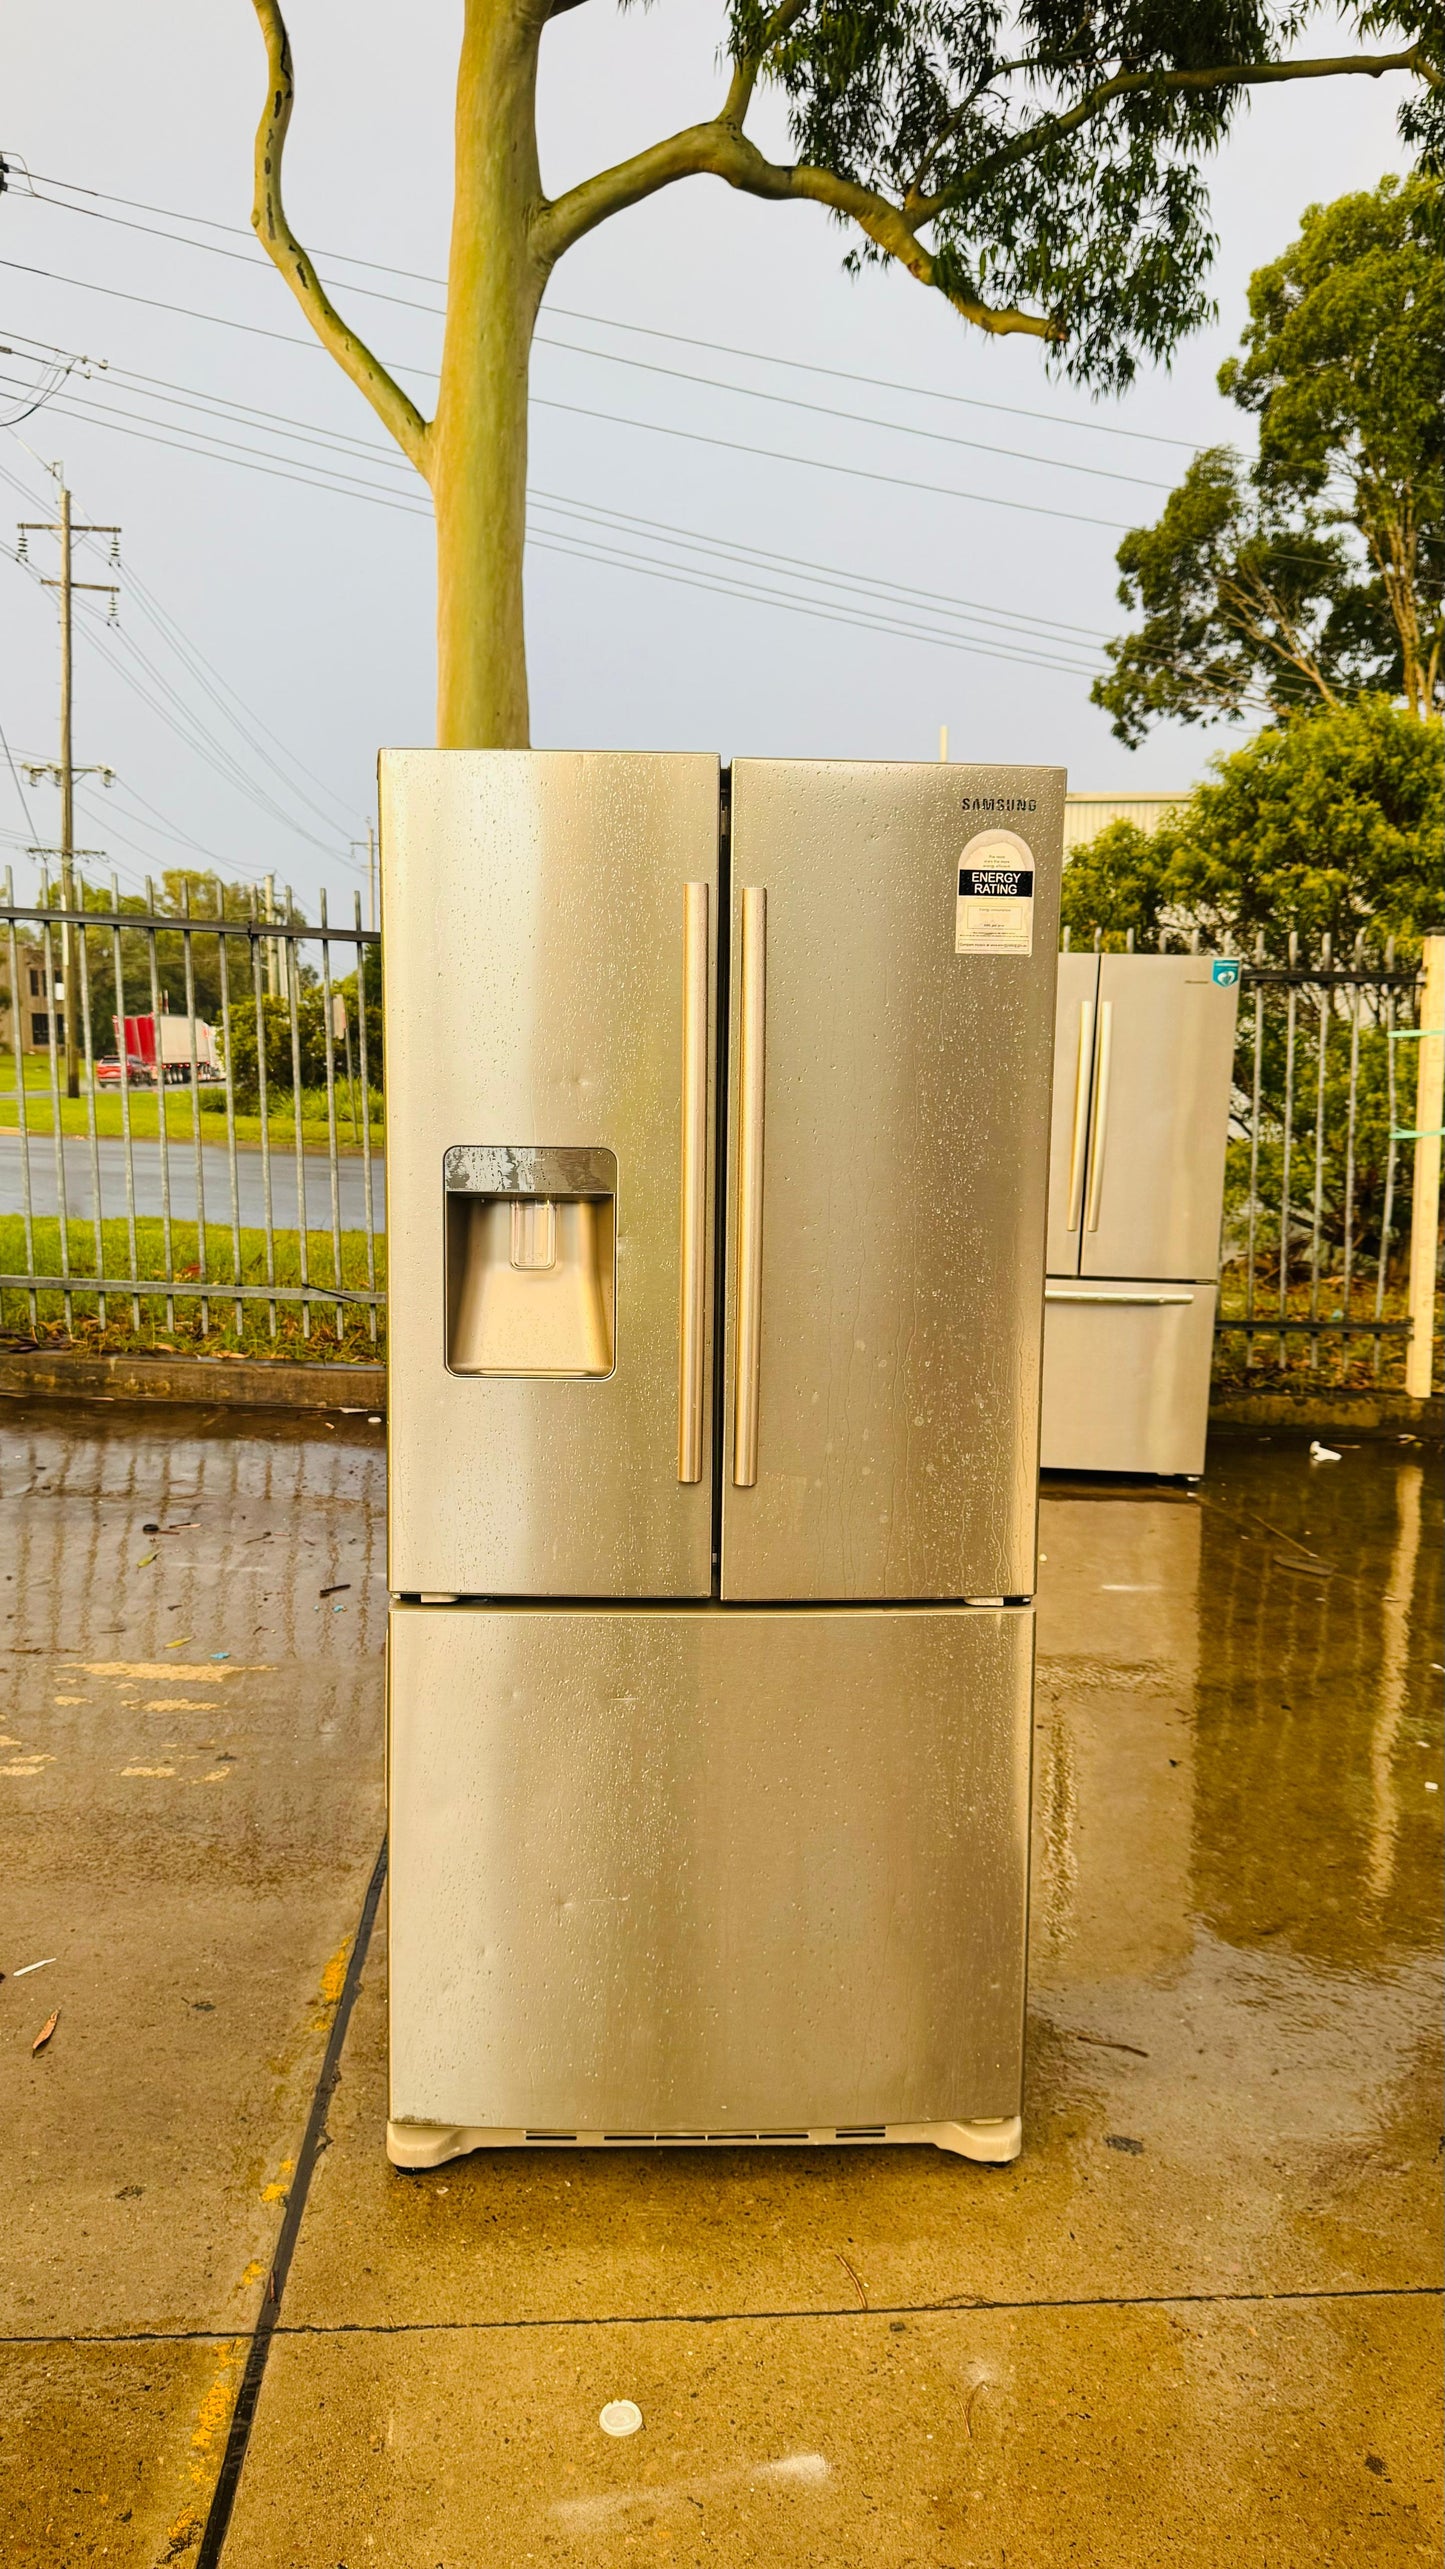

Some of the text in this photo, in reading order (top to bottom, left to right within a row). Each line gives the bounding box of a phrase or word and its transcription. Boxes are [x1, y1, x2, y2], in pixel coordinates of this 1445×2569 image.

[962, 798, 1037, 811] SAMSUNG
[971, 872, 1021, 883] ENERGY
[974, 883, 1018, 895] RATING
